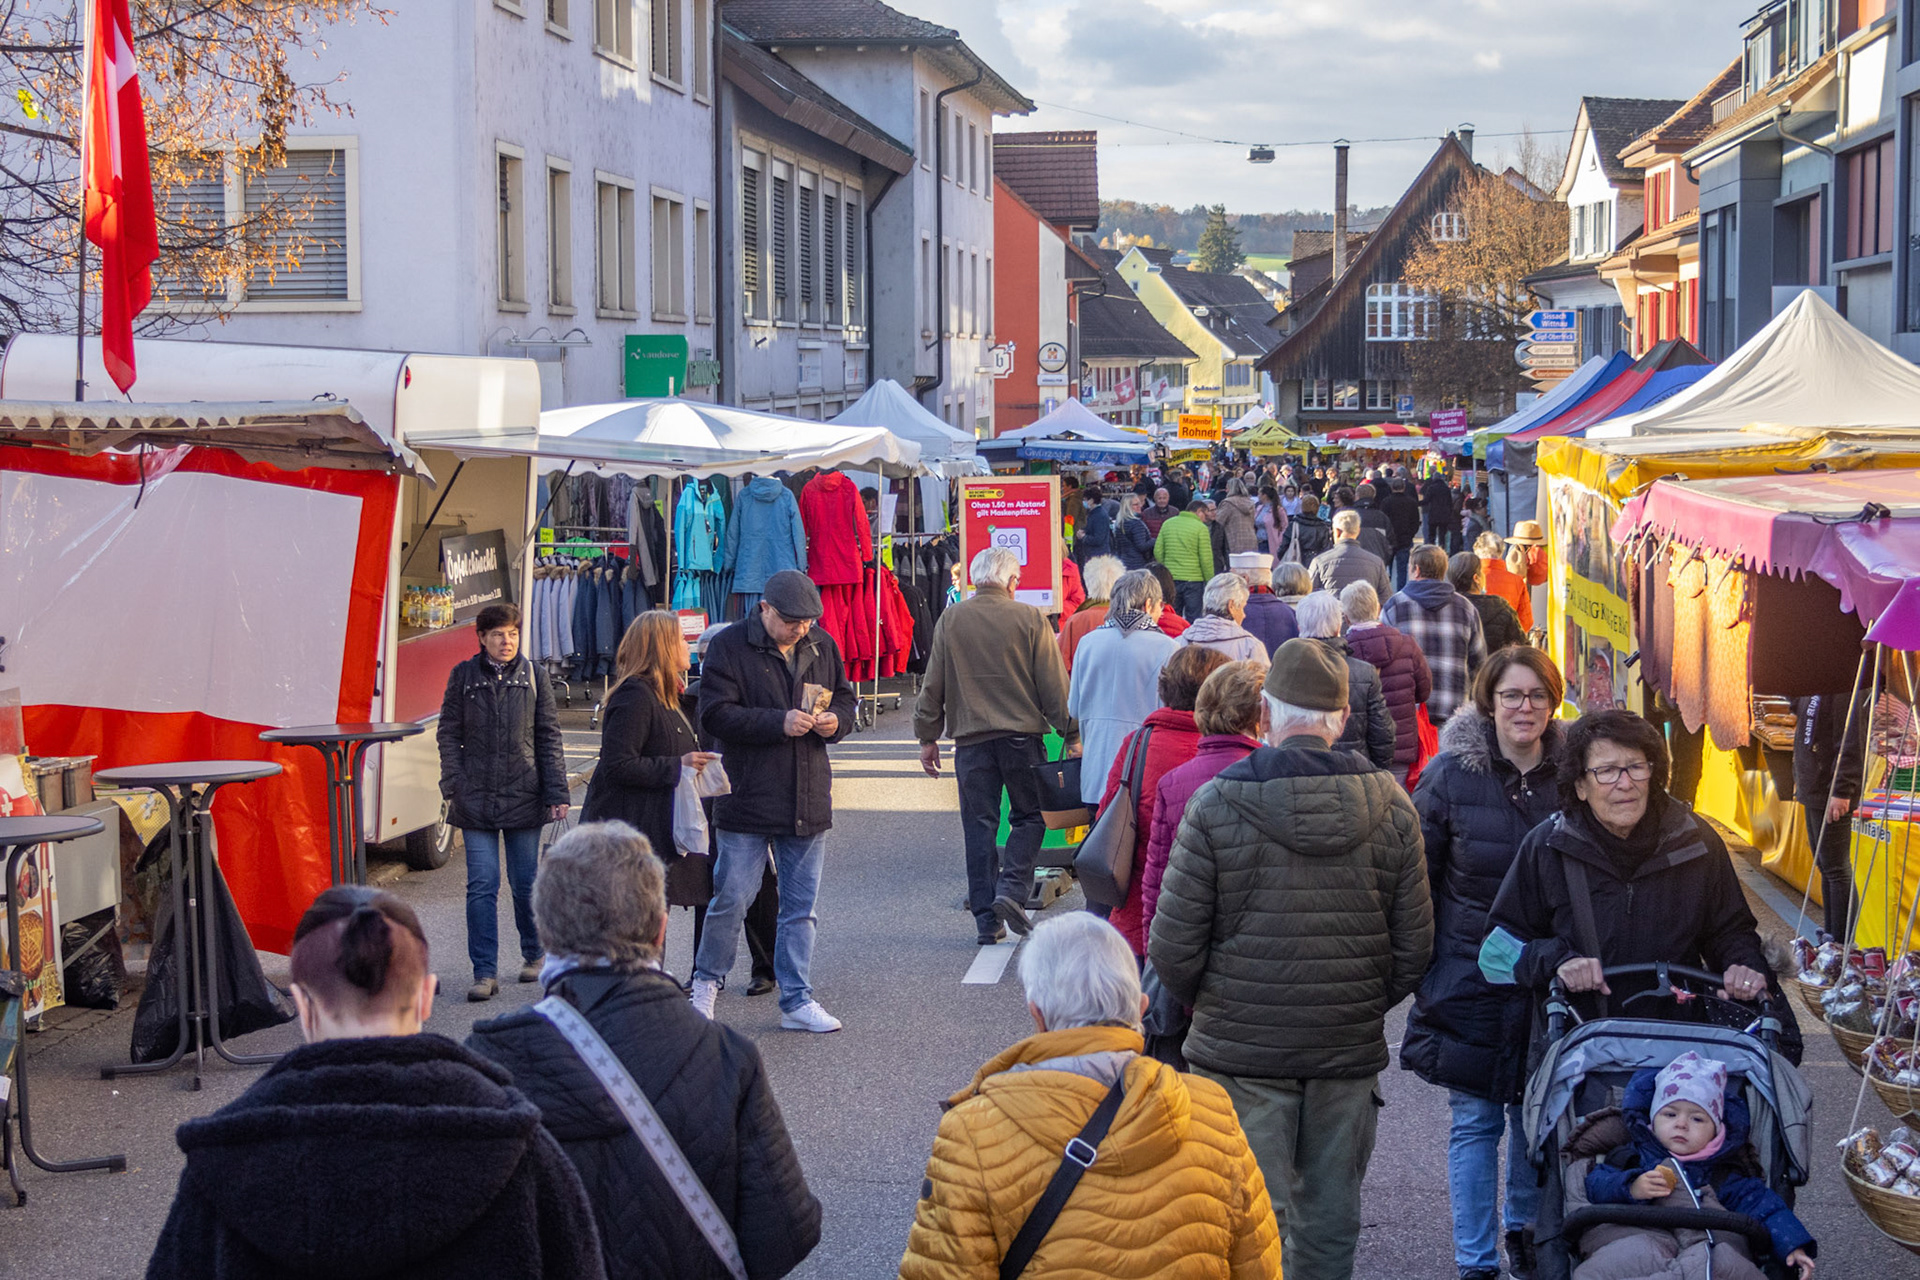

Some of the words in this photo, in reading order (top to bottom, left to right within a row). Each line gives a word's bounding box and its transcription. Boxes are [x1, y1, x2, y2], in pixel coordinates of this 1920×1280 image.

[1535, 333, 1573, 341] Gipf-Oberfrick
[642, 350, 680, 359] vaudoise
[1402, 398, 1410, 410] P
[1432, 411, 1463, 419] Magenbrot
[1182, 417, 1217, 425] Magenbr
[1182, 427, 1217, 437] Rohner
[1433, 425, 1465, 434] wohlgemut
[971, 501, 991, 509] Ohne
[1015, 500, 1046, 508] Abstand
[976, 509, 989, 518] gilt
[990, 508, 1041, 517] Maskenpflicht.
